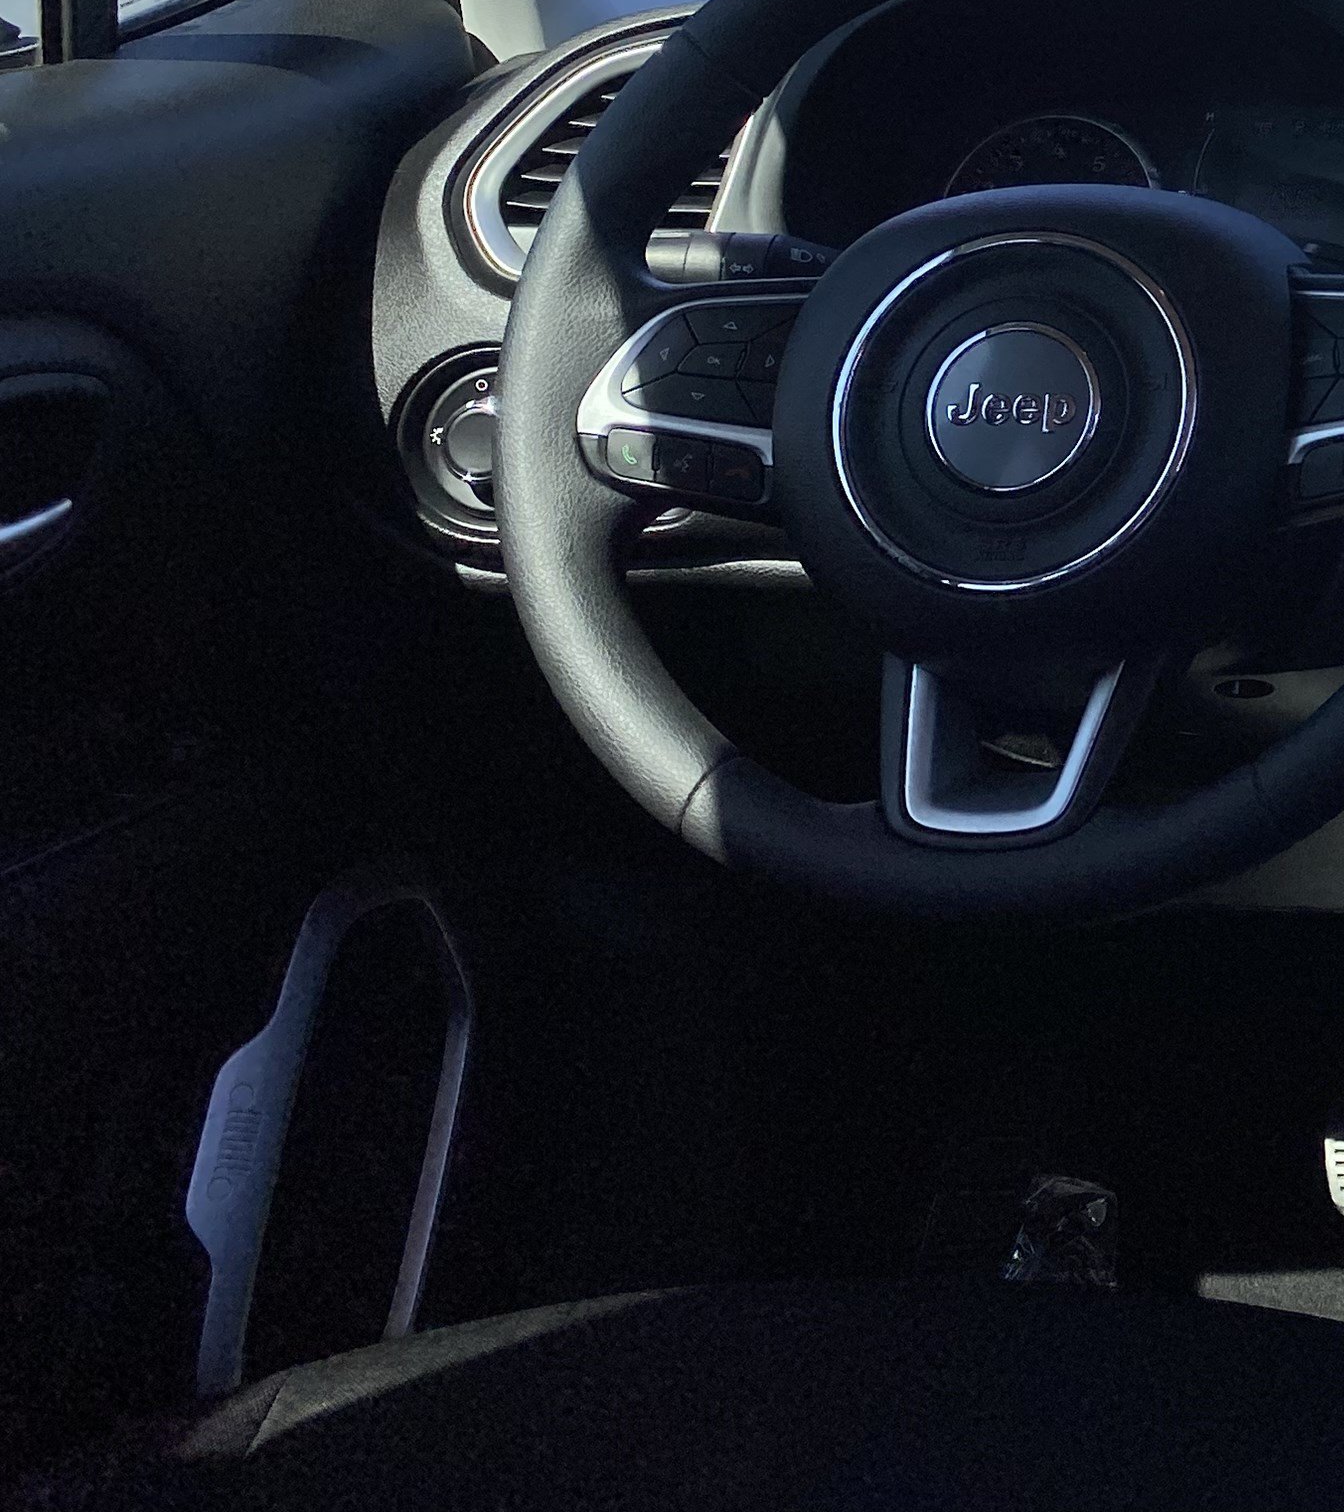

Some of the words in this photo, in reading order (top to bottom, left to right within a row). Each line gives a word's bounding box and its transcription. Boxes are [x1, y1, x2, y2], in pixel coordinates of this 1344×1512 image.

[1092, 156, 1107, 173] 5
[706, 356, 721, 366] OK
[947, 383, 1077, 433] Jeep
